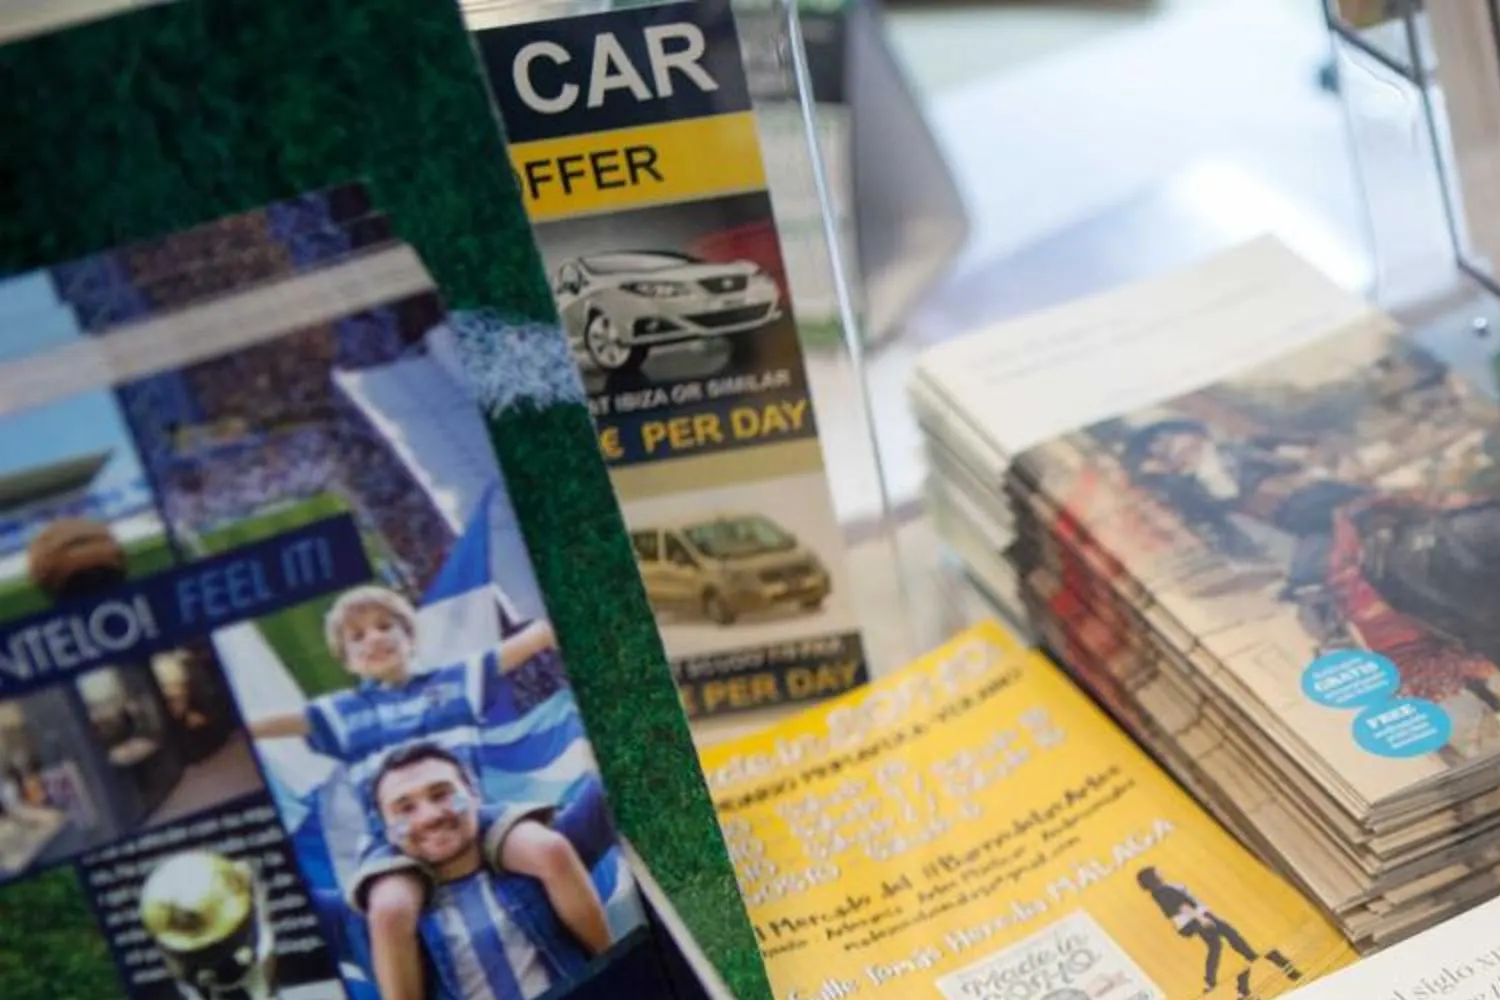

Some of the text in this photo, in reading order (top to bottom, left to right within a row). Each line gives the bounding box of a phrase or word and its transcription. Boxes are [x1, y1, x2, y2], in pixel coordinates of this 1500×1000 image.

[512, 22, 720, 115] CAR
[515, 145, 664, 200] FFER
[671, 381, 703, 405] OR
[708, 368, 792, 397] SIMILAR
[641, 411, 725, 454] PER
[729, 396, 808, 440] DAY
[174, 555, 274, 625] FEEL
[704, 671, 781, 713] PER
[786, 658, 859, 699] DAY
